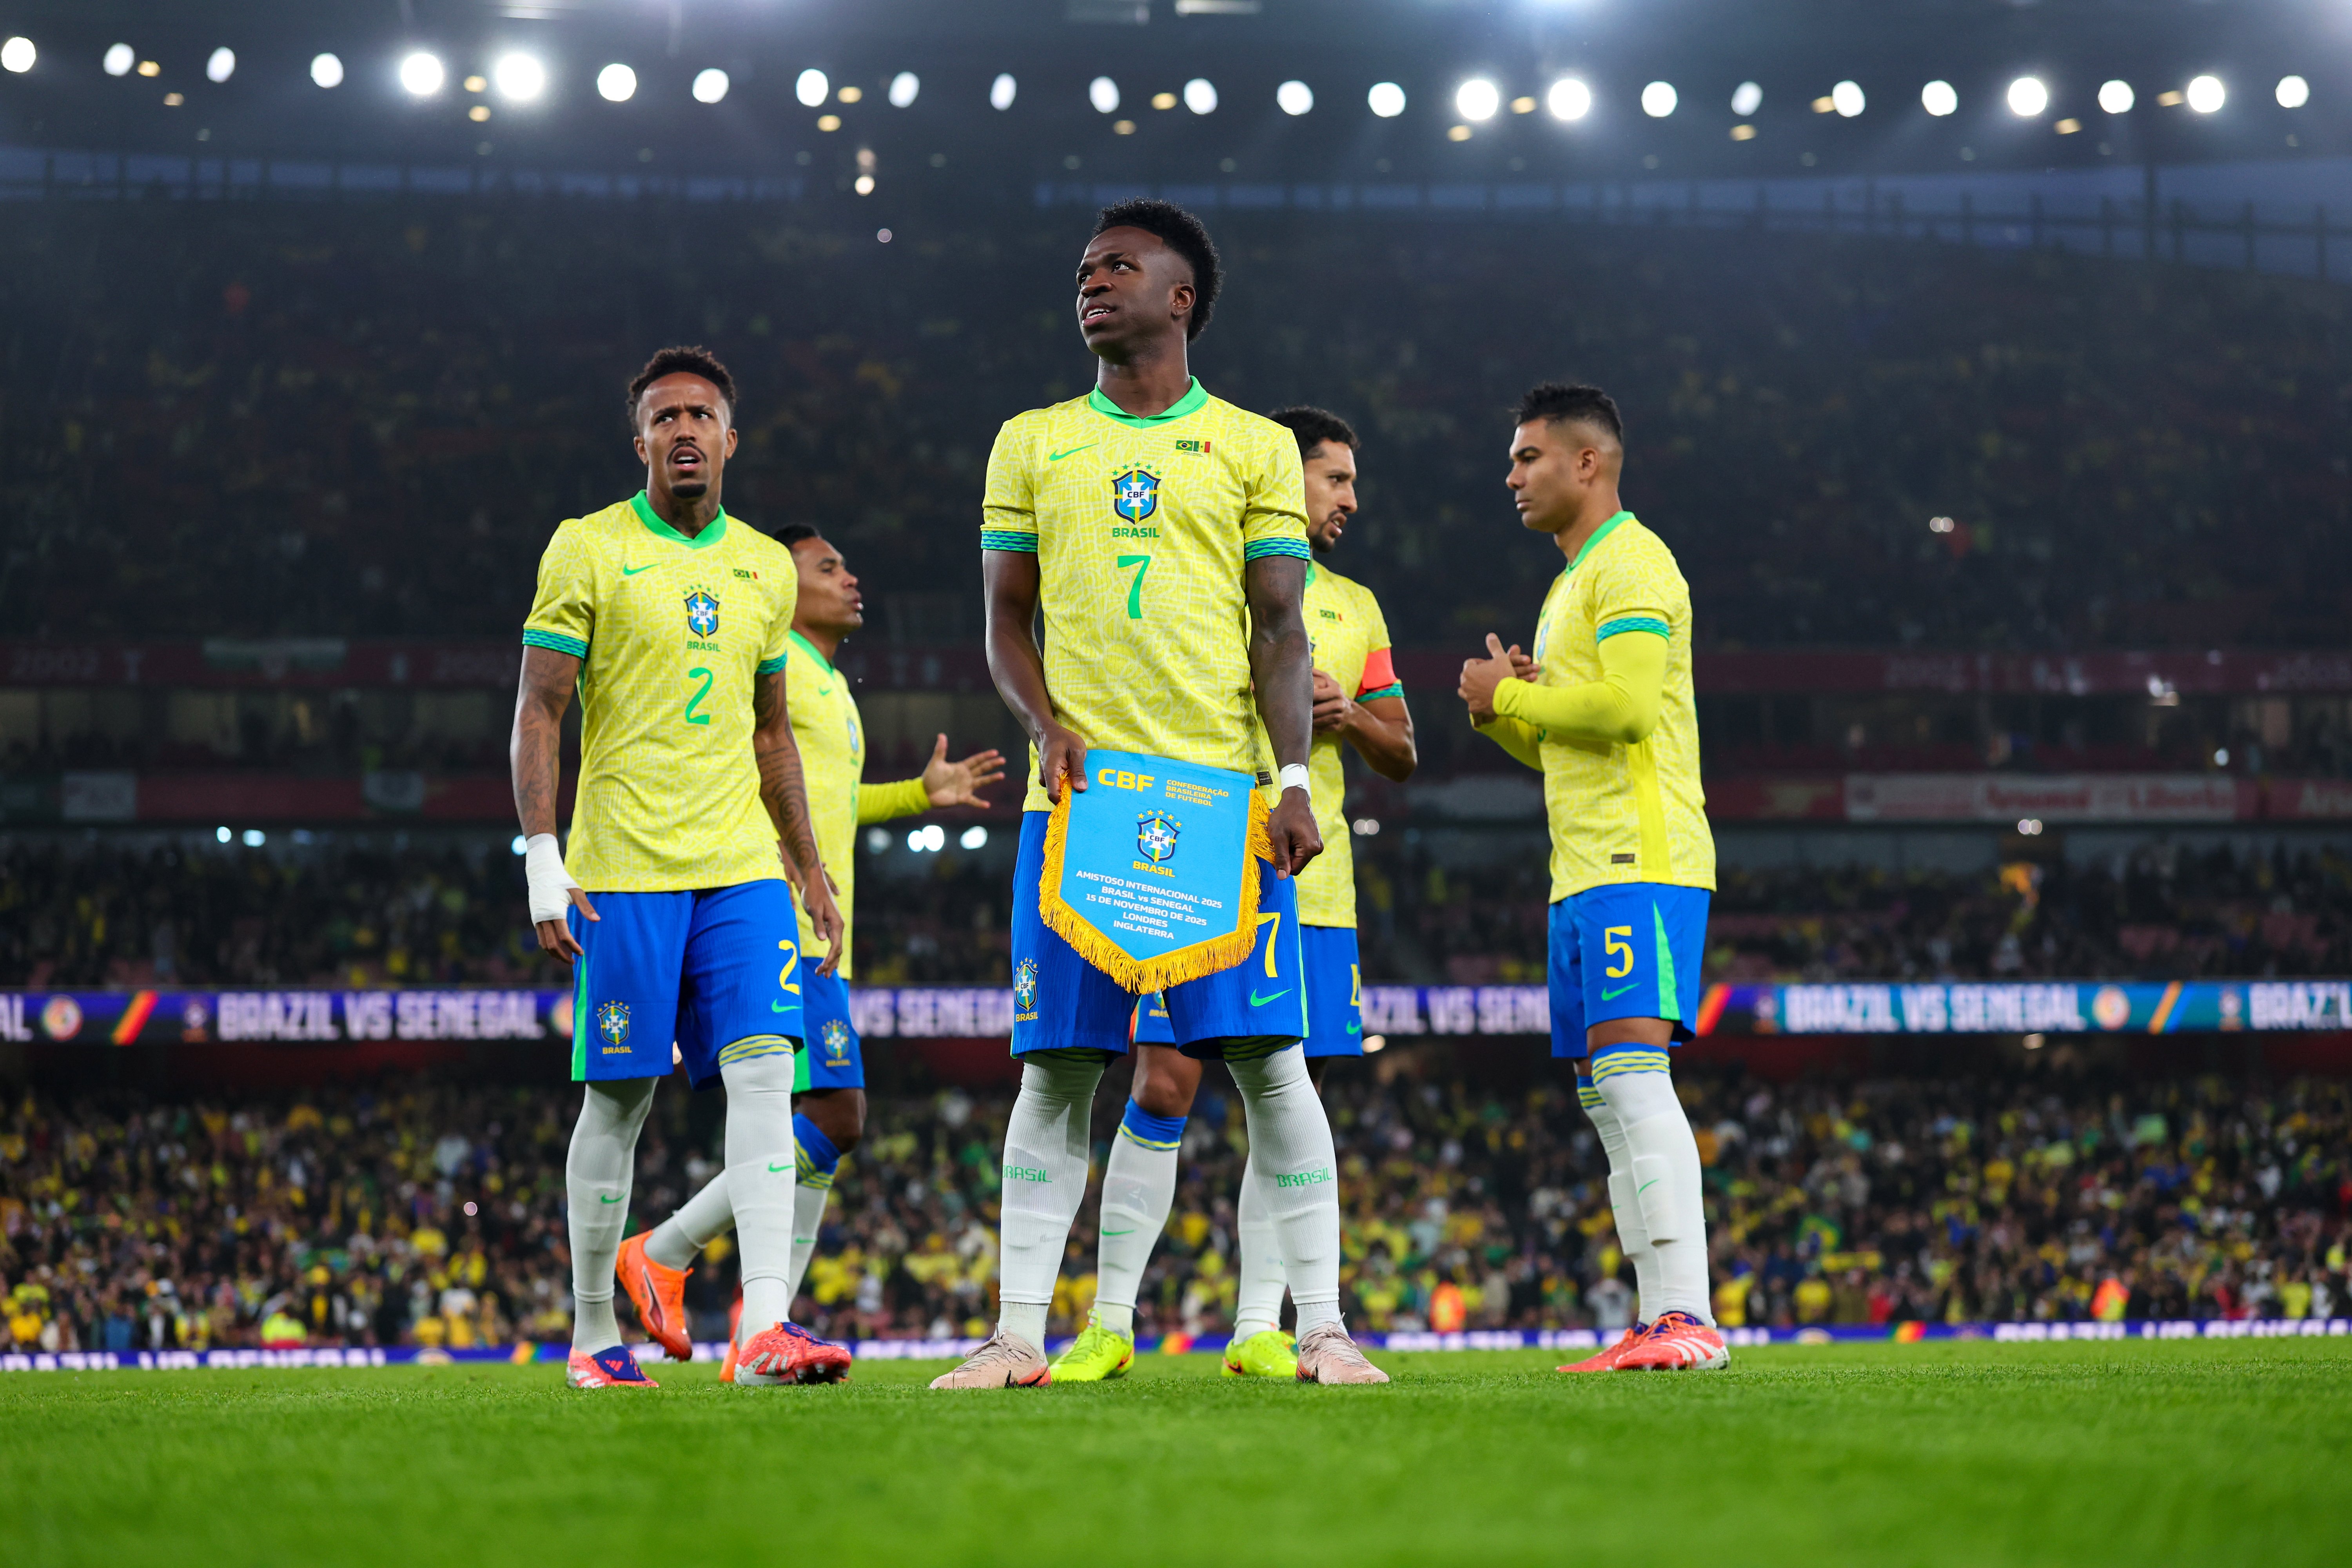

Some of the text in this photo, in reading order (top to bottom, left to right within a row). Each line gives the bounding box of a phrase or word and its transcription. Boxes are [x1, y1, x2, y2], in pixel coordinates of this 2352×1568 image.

[1112, 528, 1160, 538] BRASIL
[1118, 555, 1151, 619] 7
[687, 641, 721, 652] BRASIL
[685, 667, 713, 725] 2
[1098, 768, 1155, 792] CBF
[1167, 779, 1229, 797] CONFEDERAÇÃO
[1166, 785, 1212, 800] BRASILEIRA
[1178, 794, 1213, 807] FUTEBOL
[1132, 860, 1176, 878] BRASIL
[1076, 870, 1222, 909] AMISTOSO INTERNACIONAL 2025
[1102, 886, 1136, 900] BRASIL
[1150, 897, 1194, 913] SENEGAL
[1098, 896, 1111, 905] DE
[1113, 898, 1168, 918] NOVEMBRO
[1170, 911, 1183, 920] DE
[1185, 915, 1207, 926] 2025
[1123, 912, 1168, 927] LONDRES
[1113, 920, 1174, 940] INGLATERRA
[1256, 912, 1281, 978] 7
[1604, 926, 1634, 978] 5
[779, 940, 800, 995] 2
[218, 991, 546, 1040] BRAZIL VS SENEGAL
[1016, 1011, 1038, 1022] BRASIL
[1427, 986, 1475, 1034] VS
[1784, 984, 2086, 1032] BRAZIL VS SENEGAL
[603, 1046, 632, 1054] BRASIL
[1276, 1167, 1332, 1187] BRASIL
